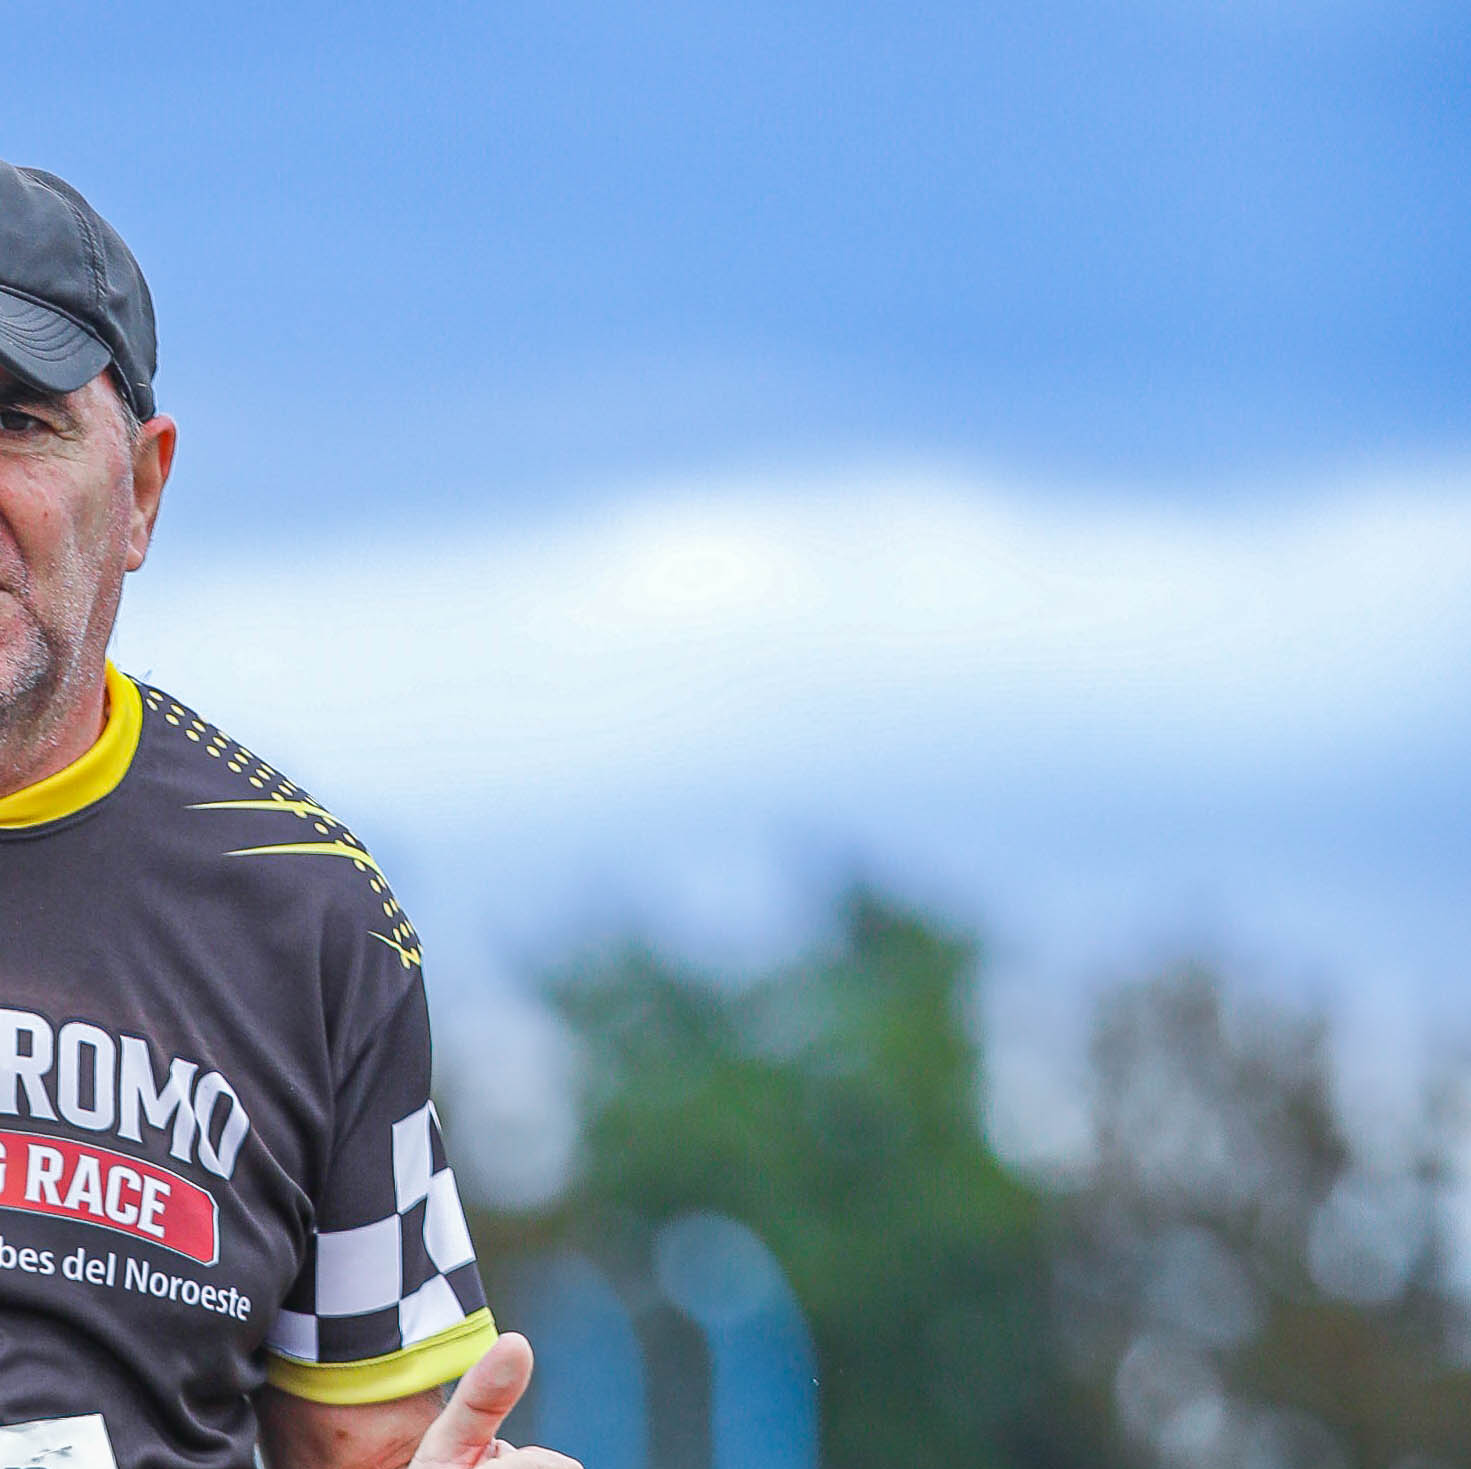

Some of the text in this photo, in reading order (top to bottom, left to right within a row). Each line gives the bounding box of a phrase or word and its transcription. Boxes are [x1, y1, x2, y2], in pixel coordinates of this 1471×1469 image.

[26, 1146, 172, 1238] RACE
[62, 1248, 115, 1287] del
[125, 1258, 252, 1322] Noroeste
